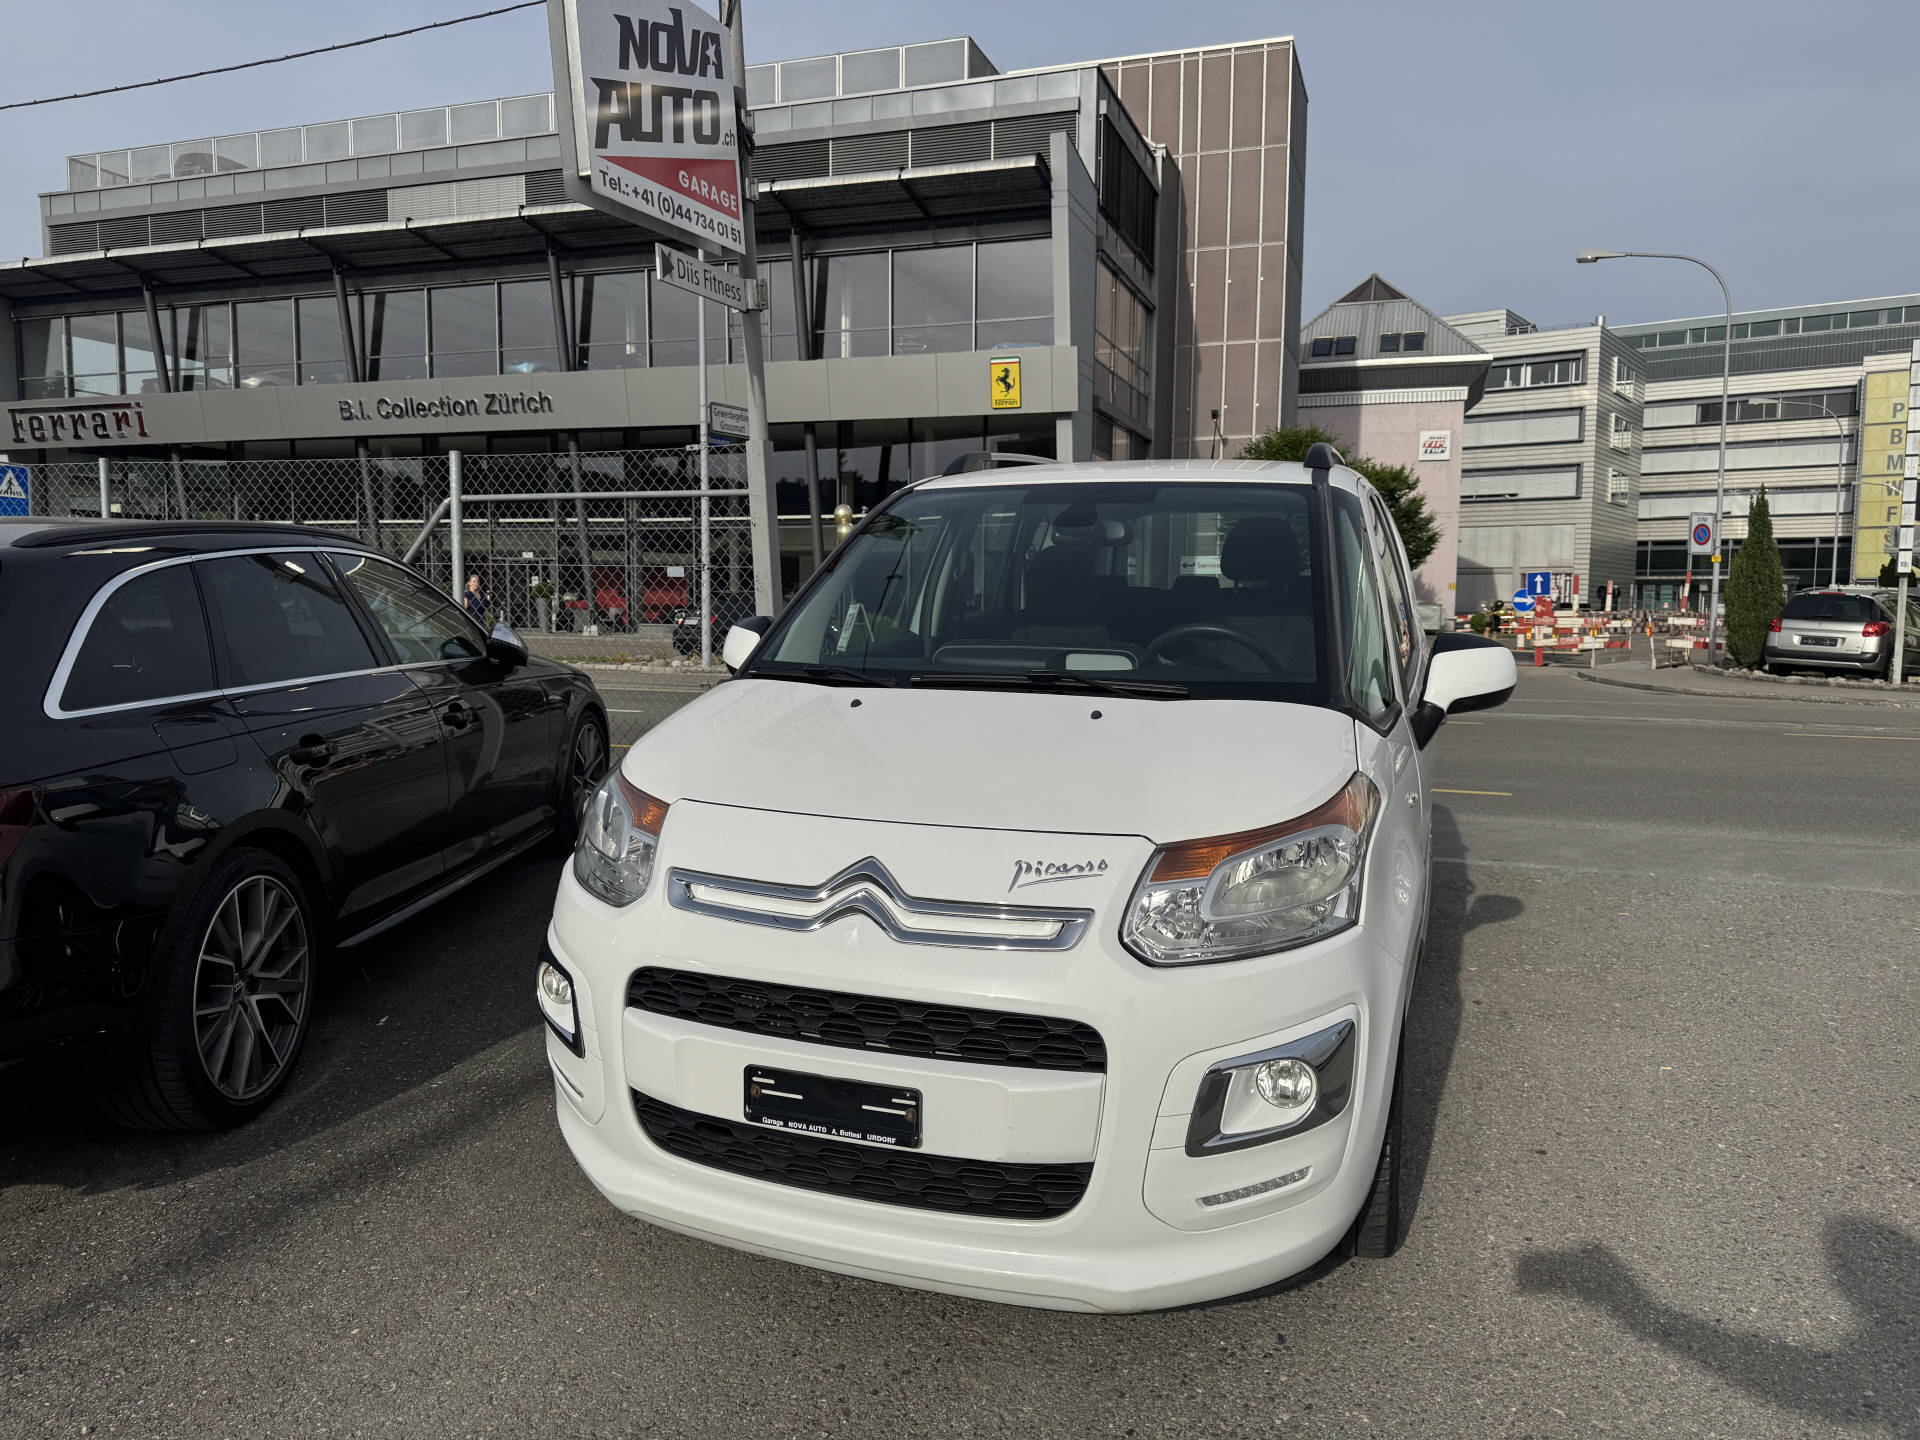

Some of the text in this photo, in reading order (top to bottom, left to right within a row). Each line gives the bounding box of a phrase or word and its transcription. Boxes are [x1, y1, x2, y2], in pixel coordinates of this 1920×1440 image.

[612, 7, 724, 79] NOVA
[590, 77, 721, 149] AUTO
[599, 169, 630, 197] Tel.:
[632, 186, 655, 208] +41
[694, 210, 715, 233] 734
[717, 221, 729, 239] 01
[731, 227, 742, 245] 51
[678, 170, 737, 212] GARAGE
[677, 258, 742, 302] Diis Fitness
[8, 402, 149, 443] Ferrari
[377, 395, 480, 419] Collection
[484, 391, 553, 415] Zürich
[762, 1116, 784, 1127] Garage
[788, 1121, 807, 1130] NOVA
[808, 1124, 827, 1133] AUTO
[866, 1133, 896, 1144] URDORF
